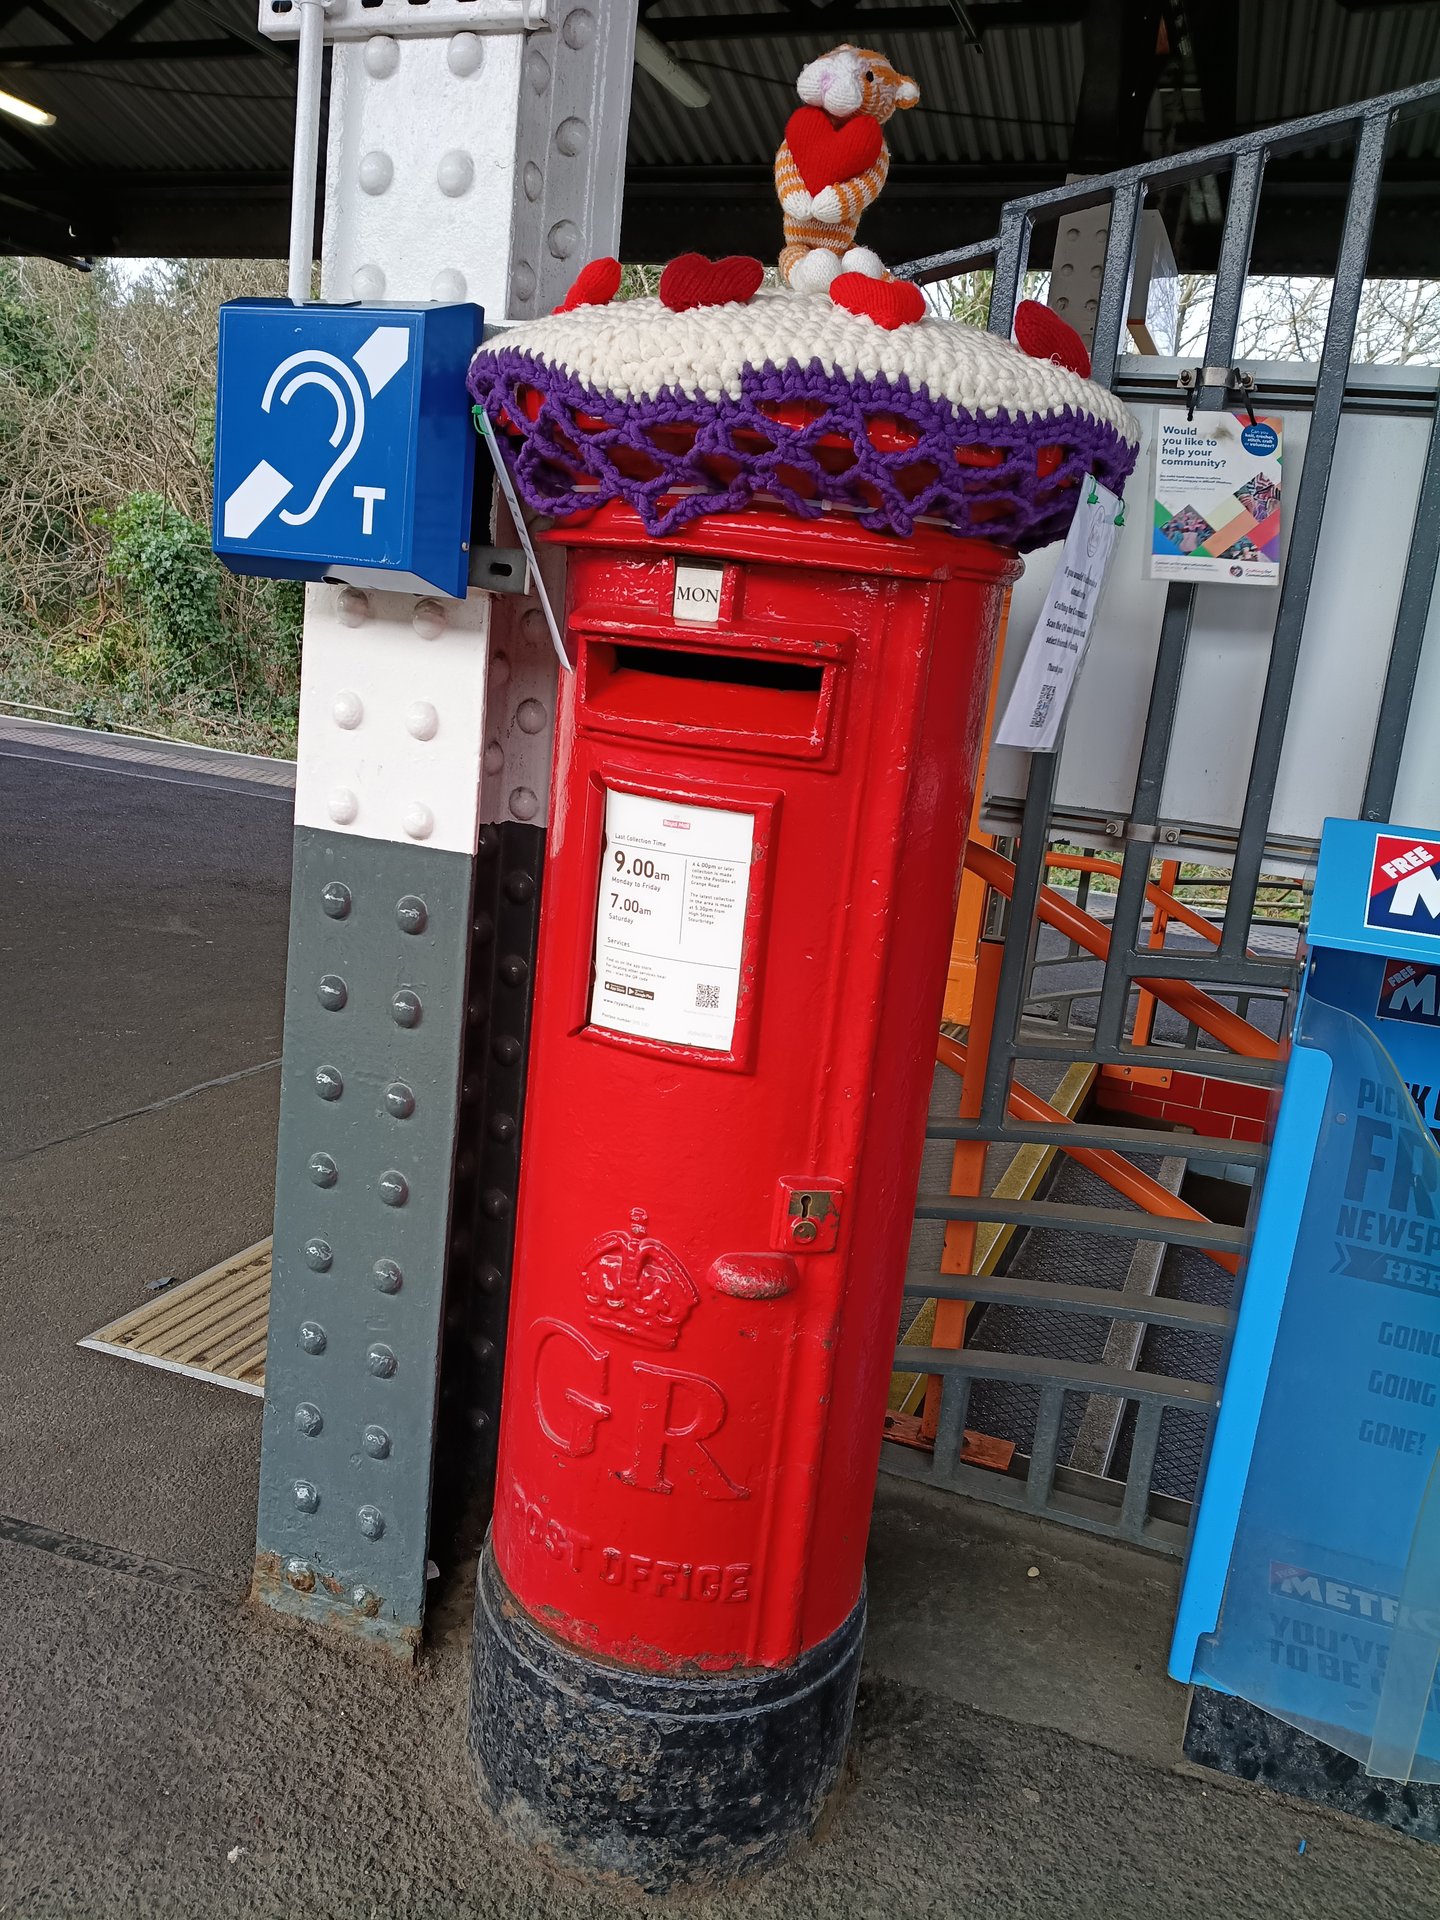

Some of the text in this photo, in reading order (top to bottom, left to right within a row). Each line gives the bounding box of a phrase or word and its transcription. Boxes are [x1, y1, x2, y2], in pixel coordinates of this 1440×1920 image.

[1162, 438, 1182, 446] you
[1184, 437, 1204, 446] like
[1163, 426, 1197, 436] Would
[1162, 446, 1212, 458] help your
[1162, 458, 1226, 469] community?
[353, 486, 386, 534] T
[676, 586, 719, 604] MON
[626, 835, 652, 845] Collection
[614, 850, 670, 881] 9.00am
[1380, 845, 1434, 880] FREE
[612, 876, 633, 887] Monday
[642, 883, 660, 892] Friday
[611, 892, 652, 916] 7.00am
[608, 913, 634, 924] Saturday
[608, 936, 630, 948] Services
[1387, 965, 1416, 987] FREE
[1368, 1369, 1436, 1408] GOING
[531, 1316, 752, 1500] GR
[1358, 1419, 1426, 1456] GONE!
[600, 1547, 752, 1604] OFFICE
[1267, 1638, 1308, 1673] TO
[1318, 1653, 1361, 1689] BE
